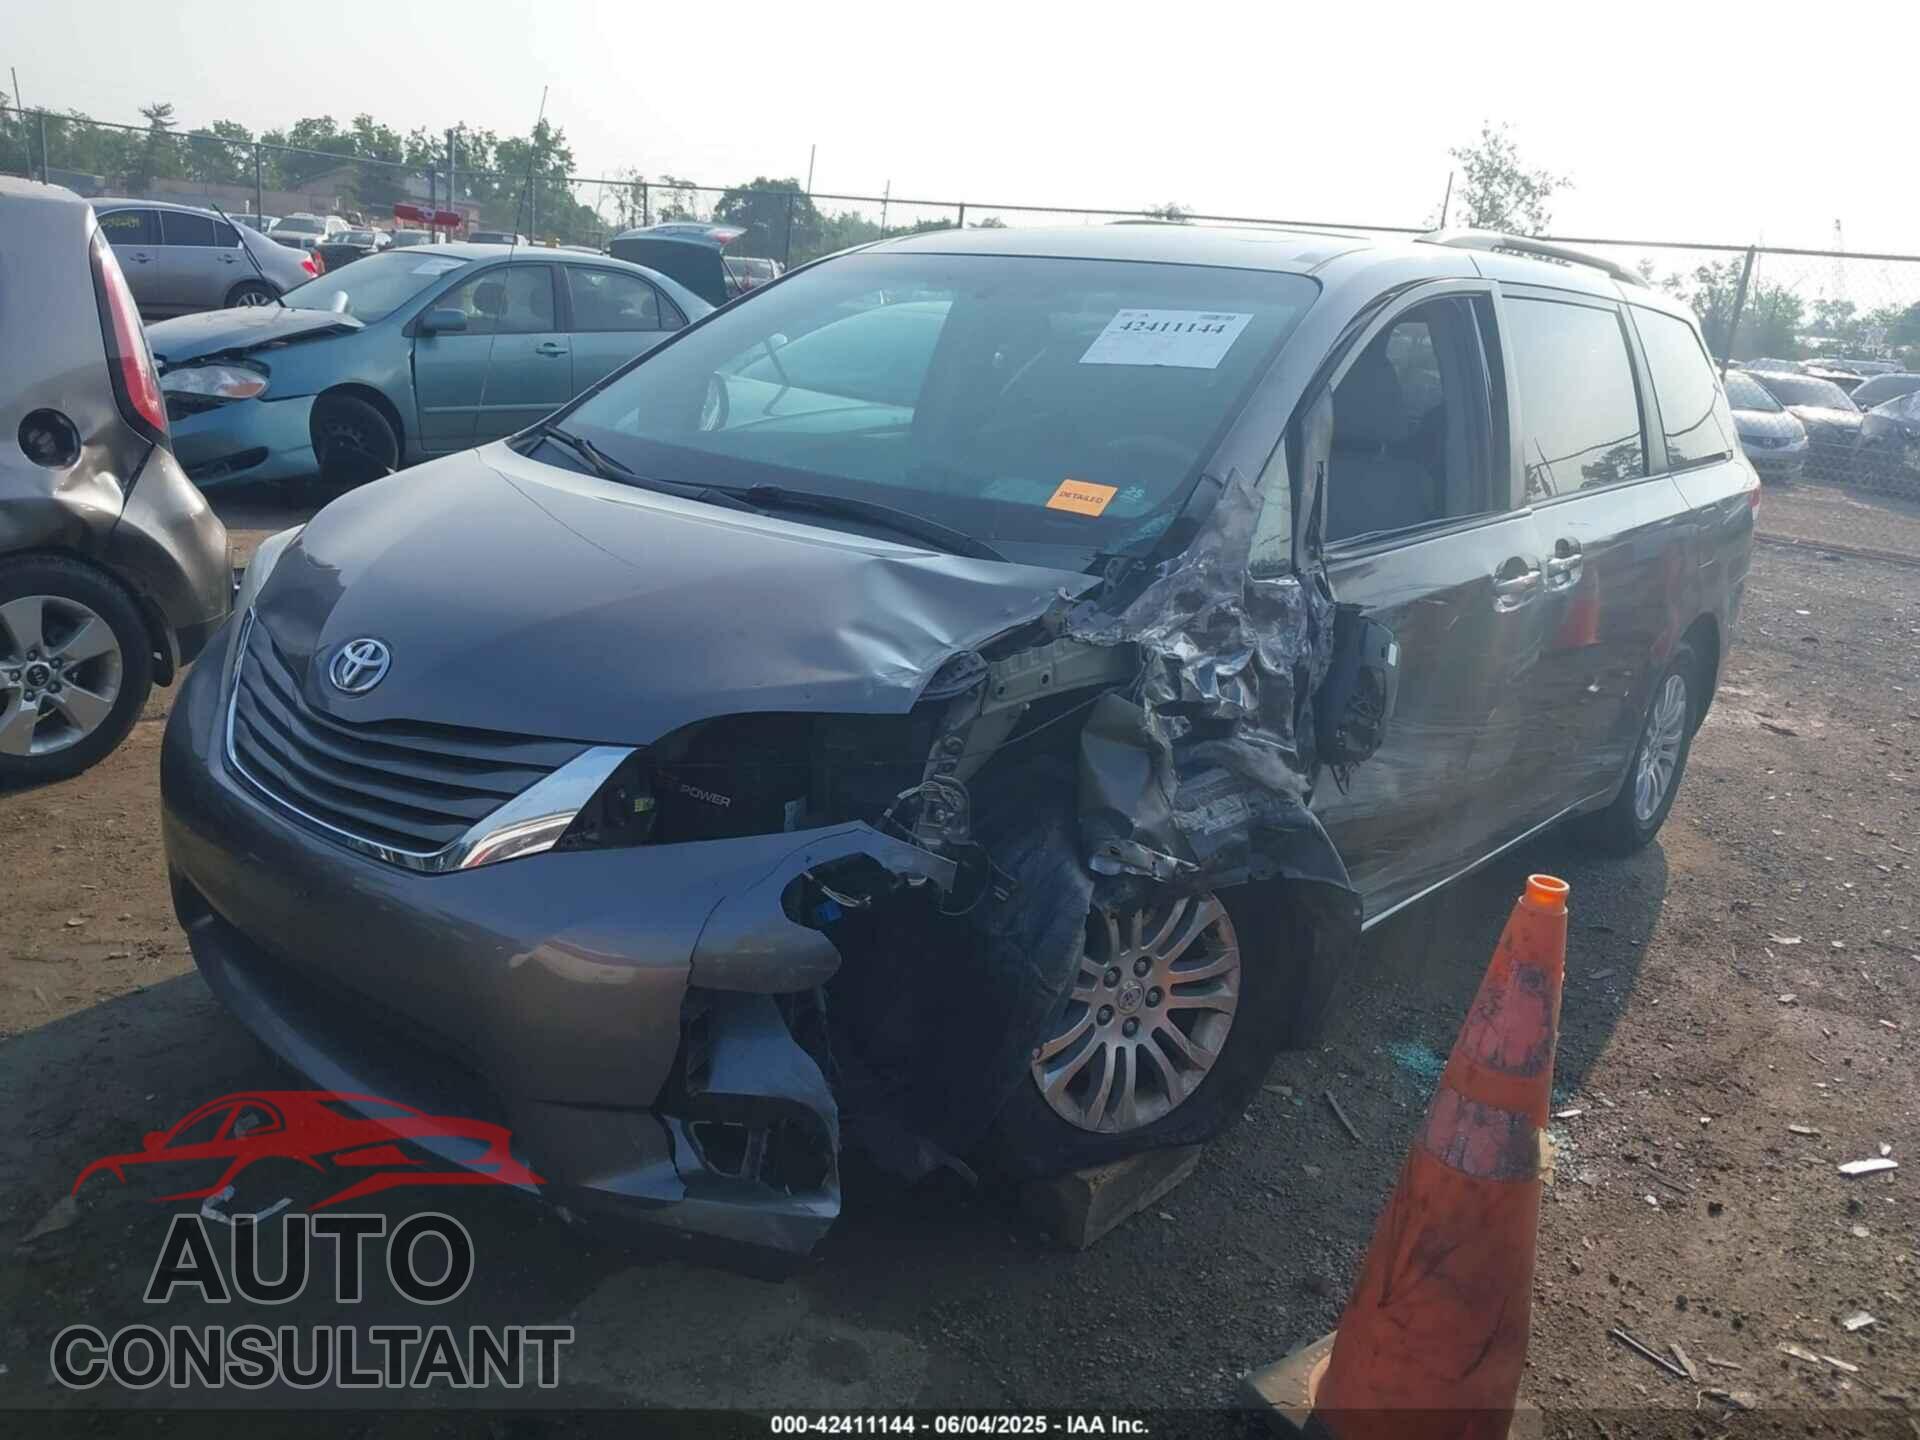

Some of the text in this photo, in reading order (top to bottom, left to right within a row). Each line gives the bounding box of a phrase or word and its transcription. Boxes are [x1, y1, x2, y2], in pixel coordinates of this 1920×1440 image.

[1120, 320, 1226, 334] 42411144
[1059, 490, 1104, 504] DETAILED
[681, 784, 731, 807] POWER
